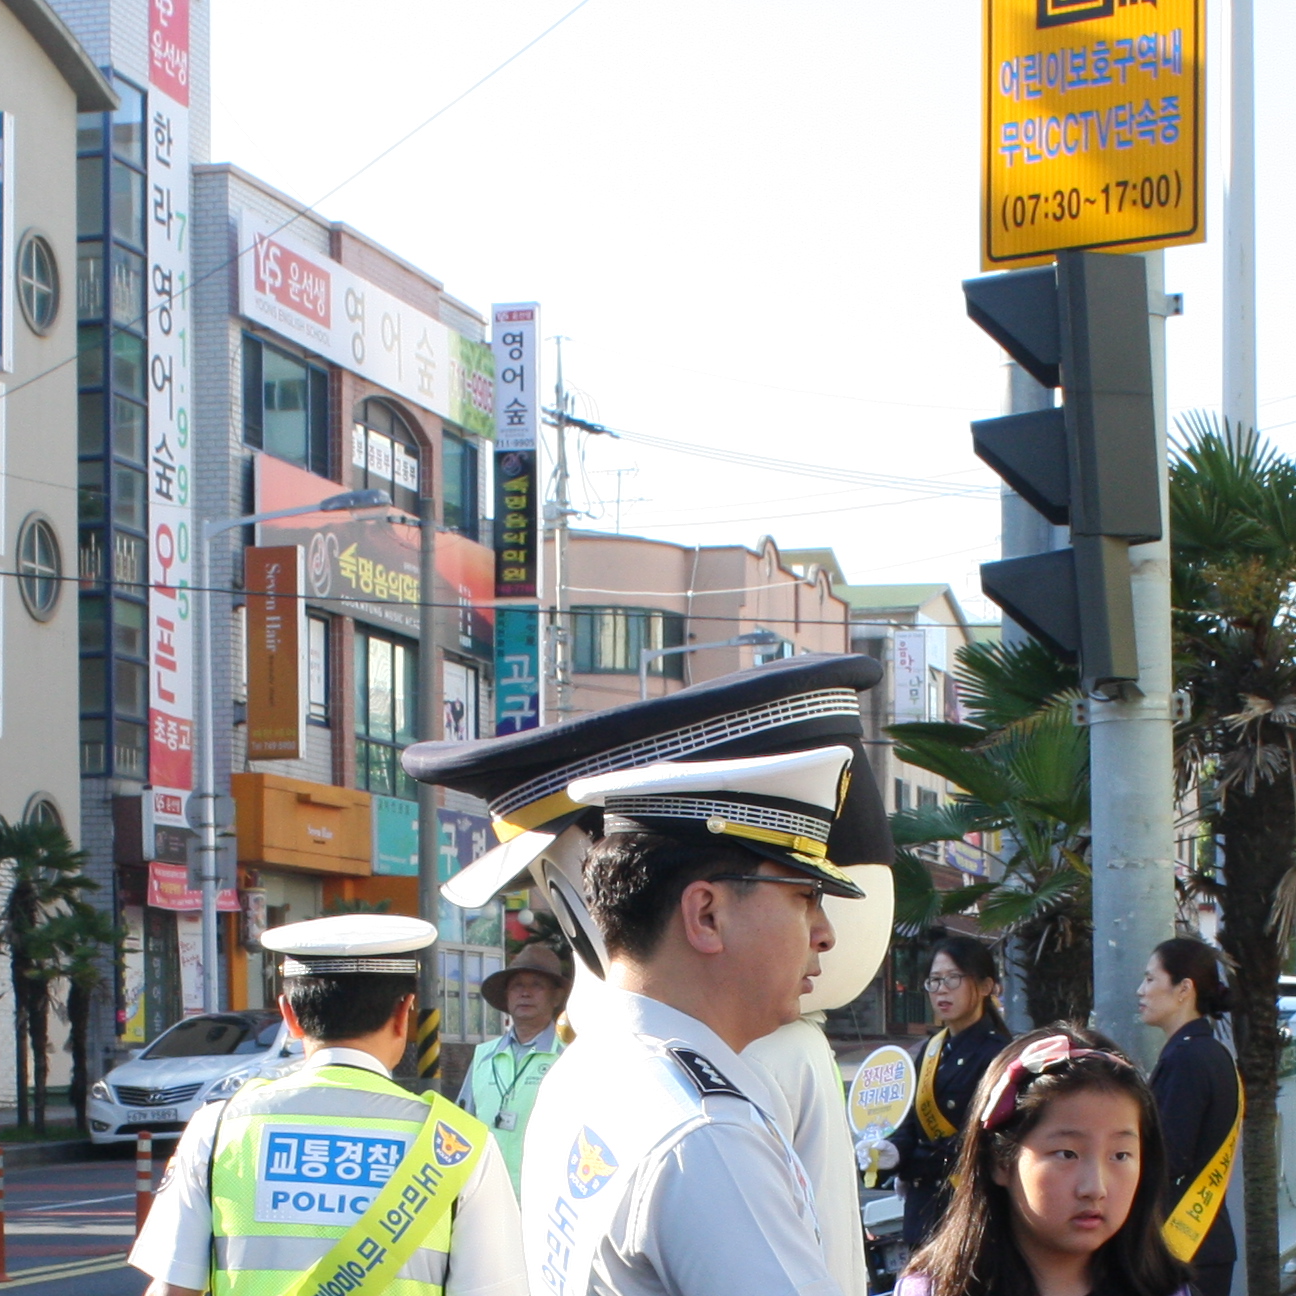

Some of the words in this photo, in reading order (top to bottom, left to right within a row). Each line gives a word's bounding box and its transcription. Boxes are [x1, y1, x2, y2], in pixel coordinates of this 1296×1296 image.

[151, 29, 187, 86] 윤선생
[1000, 28, 1182, 102] 어린이보호구역내
[999, 95, 1182, 168] 무인CCTV단속중
[1001, 170, 1182, 232] (07:30~17:00)
[288, 262, 326, 317] 윤선생
[345, 287, 436, 400] 영어숲
[502, 331, 529, 427] 영어숲
[265, 562, 281, 611] Seven
[338, 542, 421, 609] 숙명음악학
[265, 616, 281, 652] Hair
[500, 654, 537, 732] 고구
[153, 719, 192, 753] 초중고
[857, 1083, 905, 1107] 지키세요!
[863, 1061, 905, 1088] 정지선을
[270, 1137, 401, 1185] 교통경찰
[272, 1189, 378, 1215] POLIC
[379, 1162, 443, 1244] 도민의
